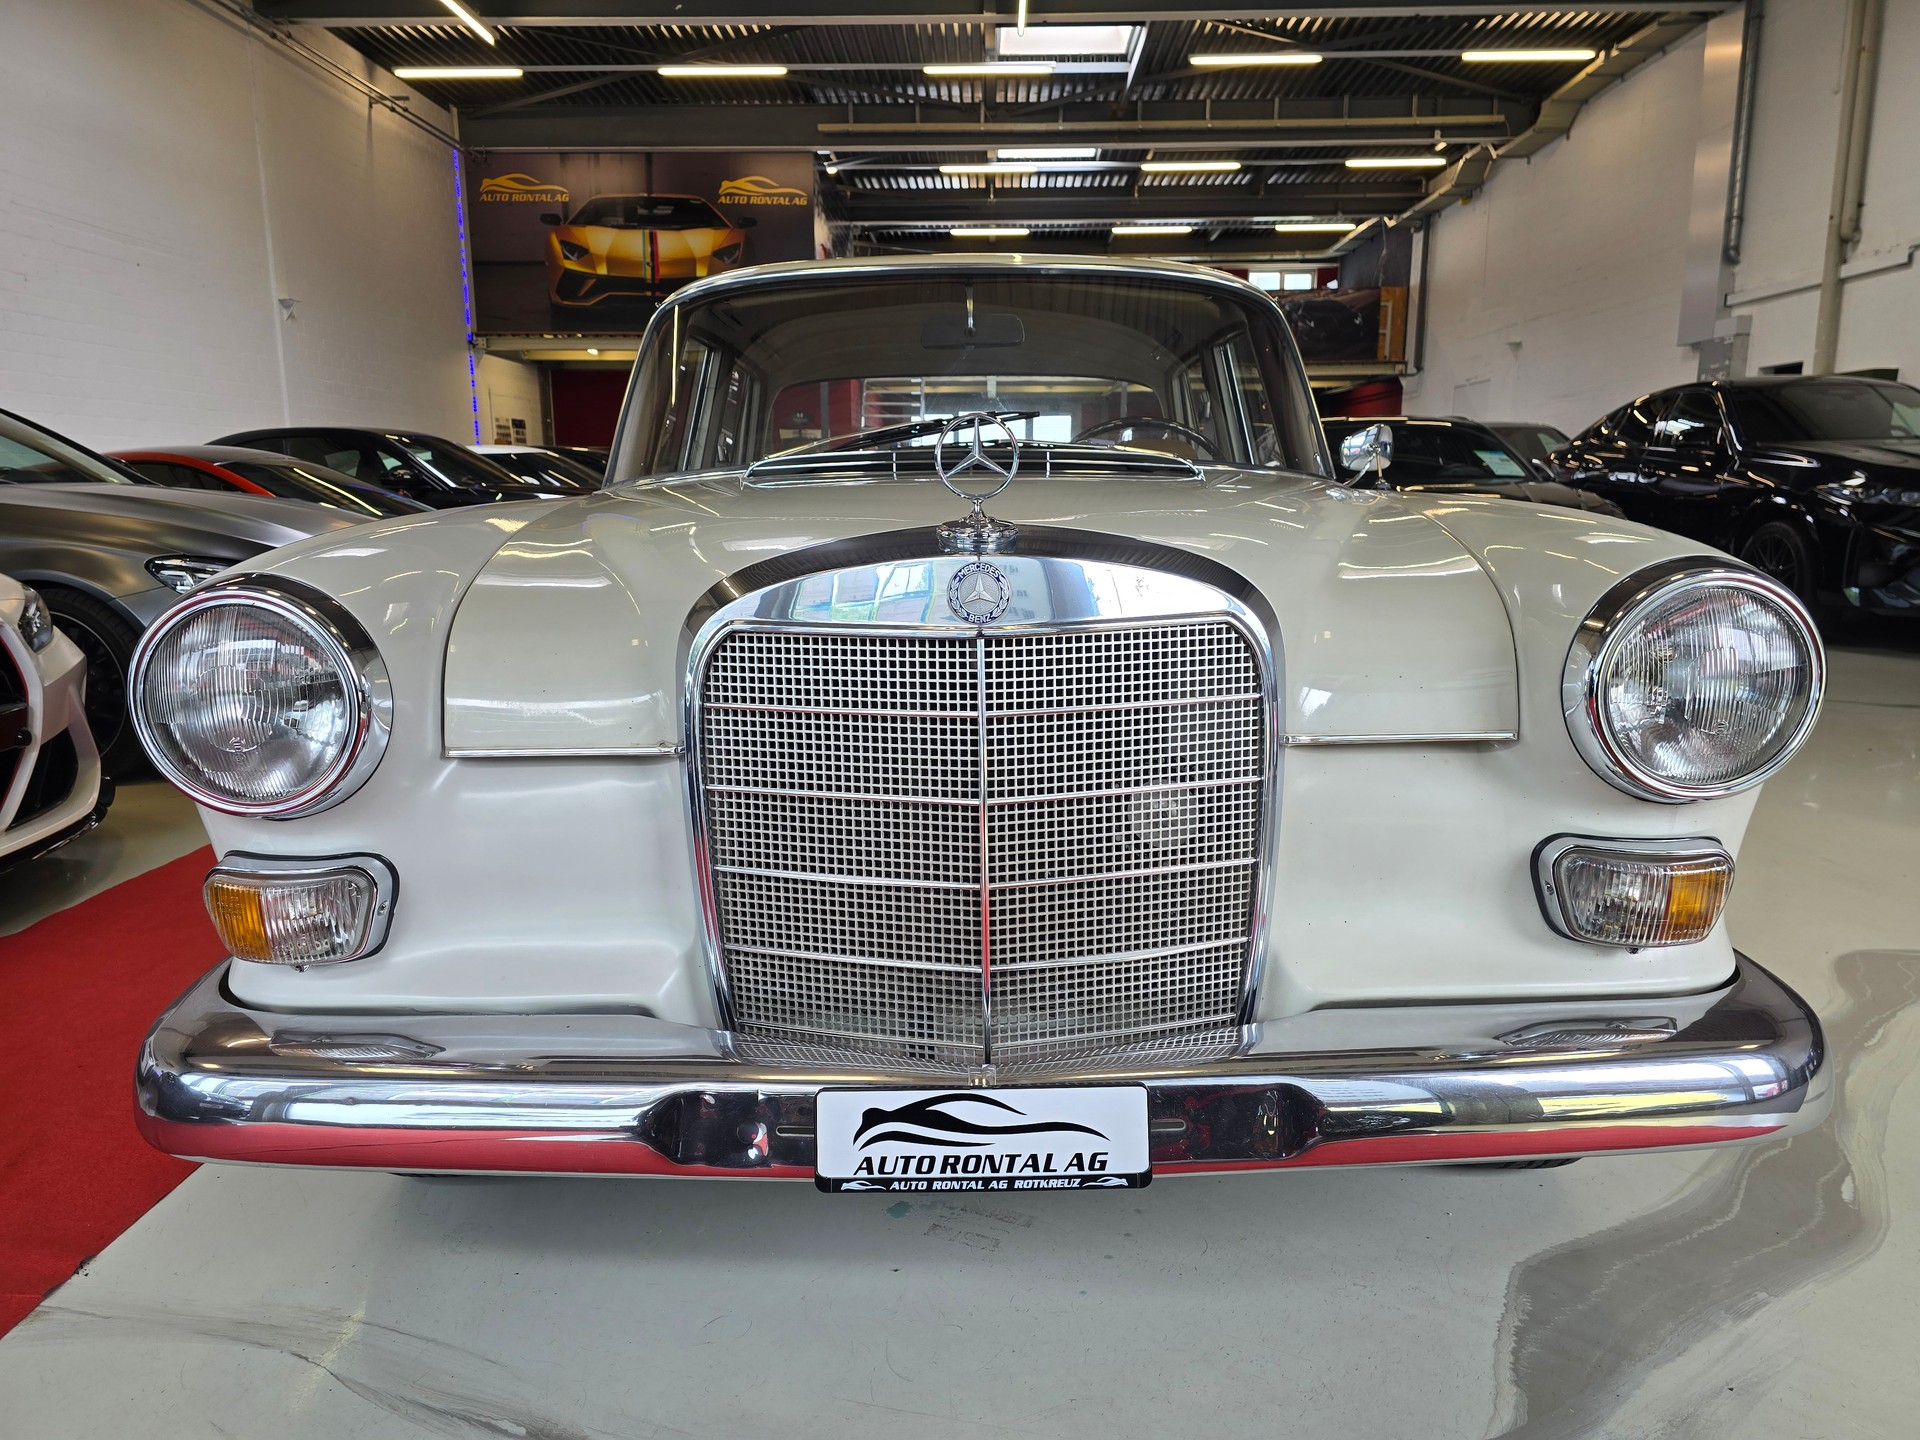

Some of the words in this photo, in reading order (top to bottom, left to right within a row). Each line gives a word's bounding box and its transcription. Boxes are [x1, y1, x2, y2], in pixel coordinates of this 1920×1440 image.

[480, 193, 509, 202] AUTO
[512, 193, 552, 202] RONTAL
[554, 193, 569, 202] AG
[718, 195, 747, 204] AUTO
[749, 196, 790, 205] RONTAL
[792, 197, 808, 206] AG
[958, 563, 1000, 579] MERCEDES
[968, 613, 992, 623] BENZ
[853, 1155, 937, 1176] AUTO
[939, 1152, 1058, 1175] RONTAL
[1063, 1151, 1109, 1173] AG
[889, 1181, 928, 1191] AUTO
[932, 1180, 985, 1191] RONTAL
[988, 1180, 1008, 1190] AG
[1014, 1178, 1081, 1189] ROTKREUZ
